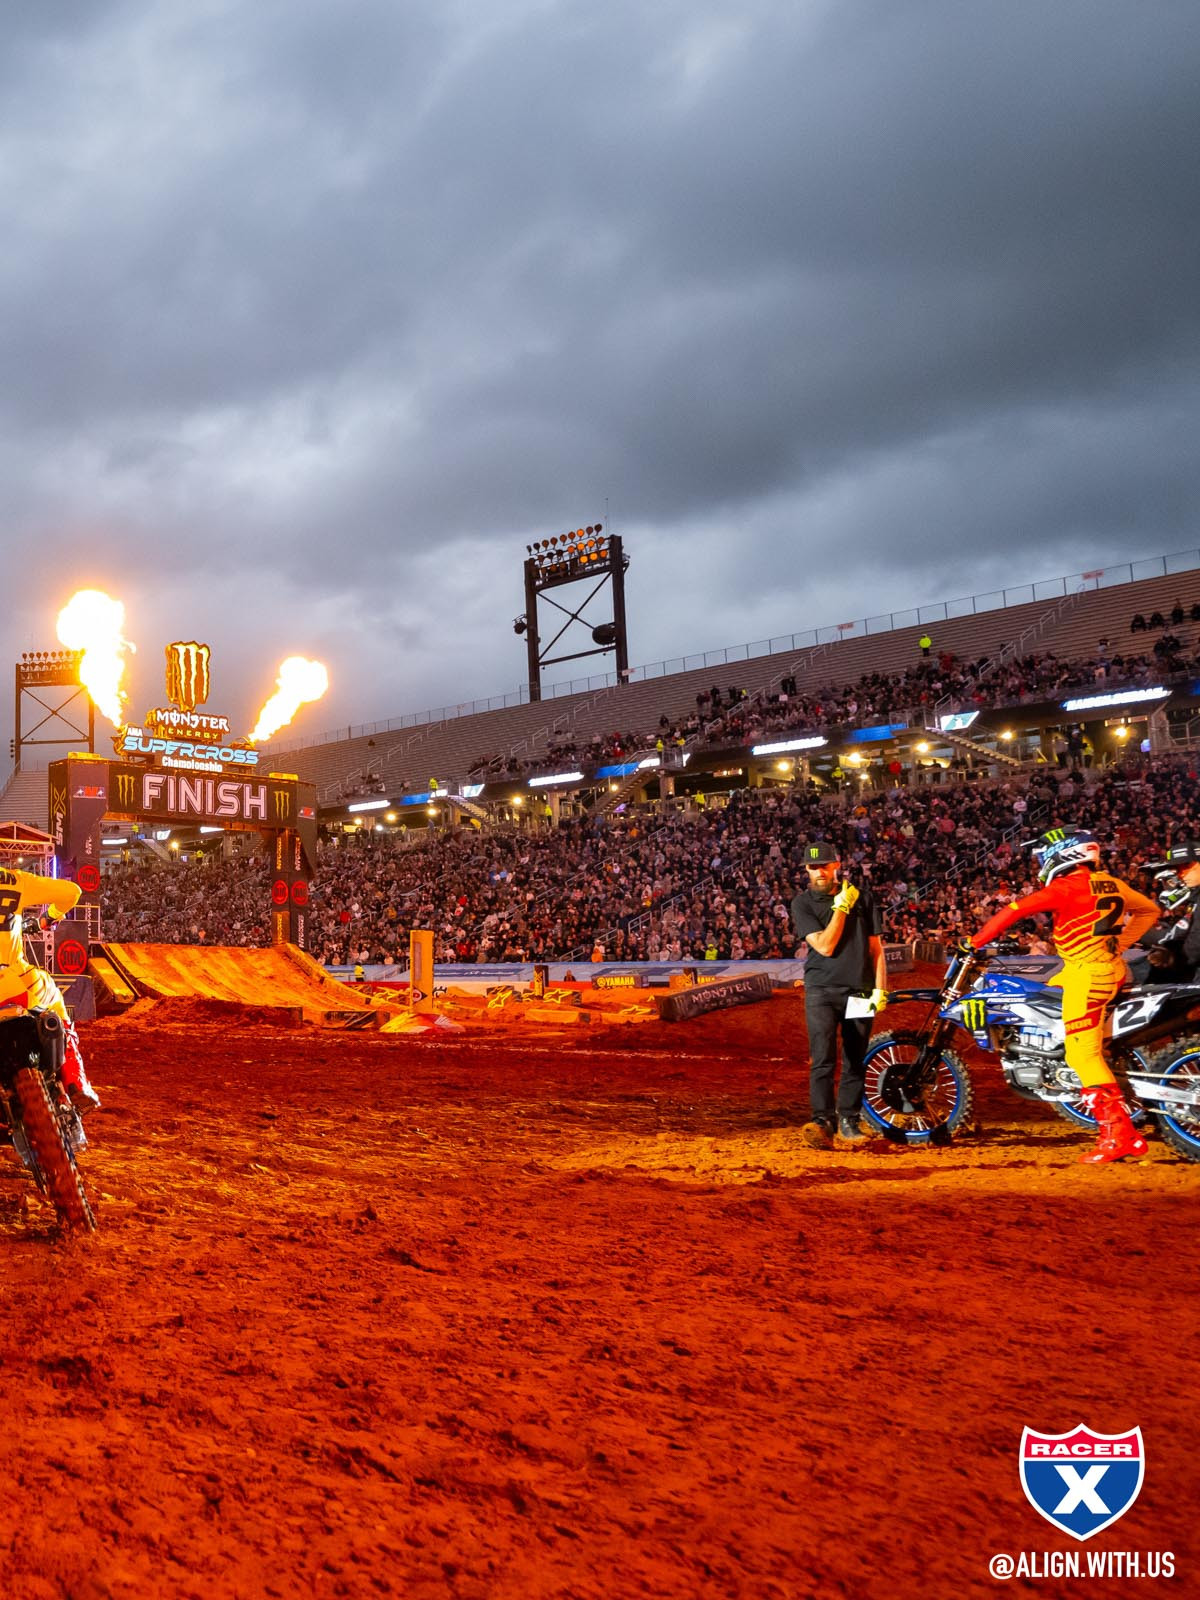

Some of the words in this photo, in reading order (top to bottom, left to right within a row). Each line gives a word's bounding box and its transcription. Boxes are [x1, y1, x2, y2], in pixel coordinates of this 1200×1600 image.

[156, 710, 230, 732] MONSTER
[168, 727, 219, 739] ENERGY
[123, 736, 260, 765] SUPERCROSS
[161, 755, 223, 773] Championship
[142, 773, 268, 821] FINISH
[1092, 895, 1126, 937] 2
[605, 976, 635, 986] YAMAHA
[691, 981, 754, 1003] MONSTER
[1118, 1000, 1147, 1029] 2
